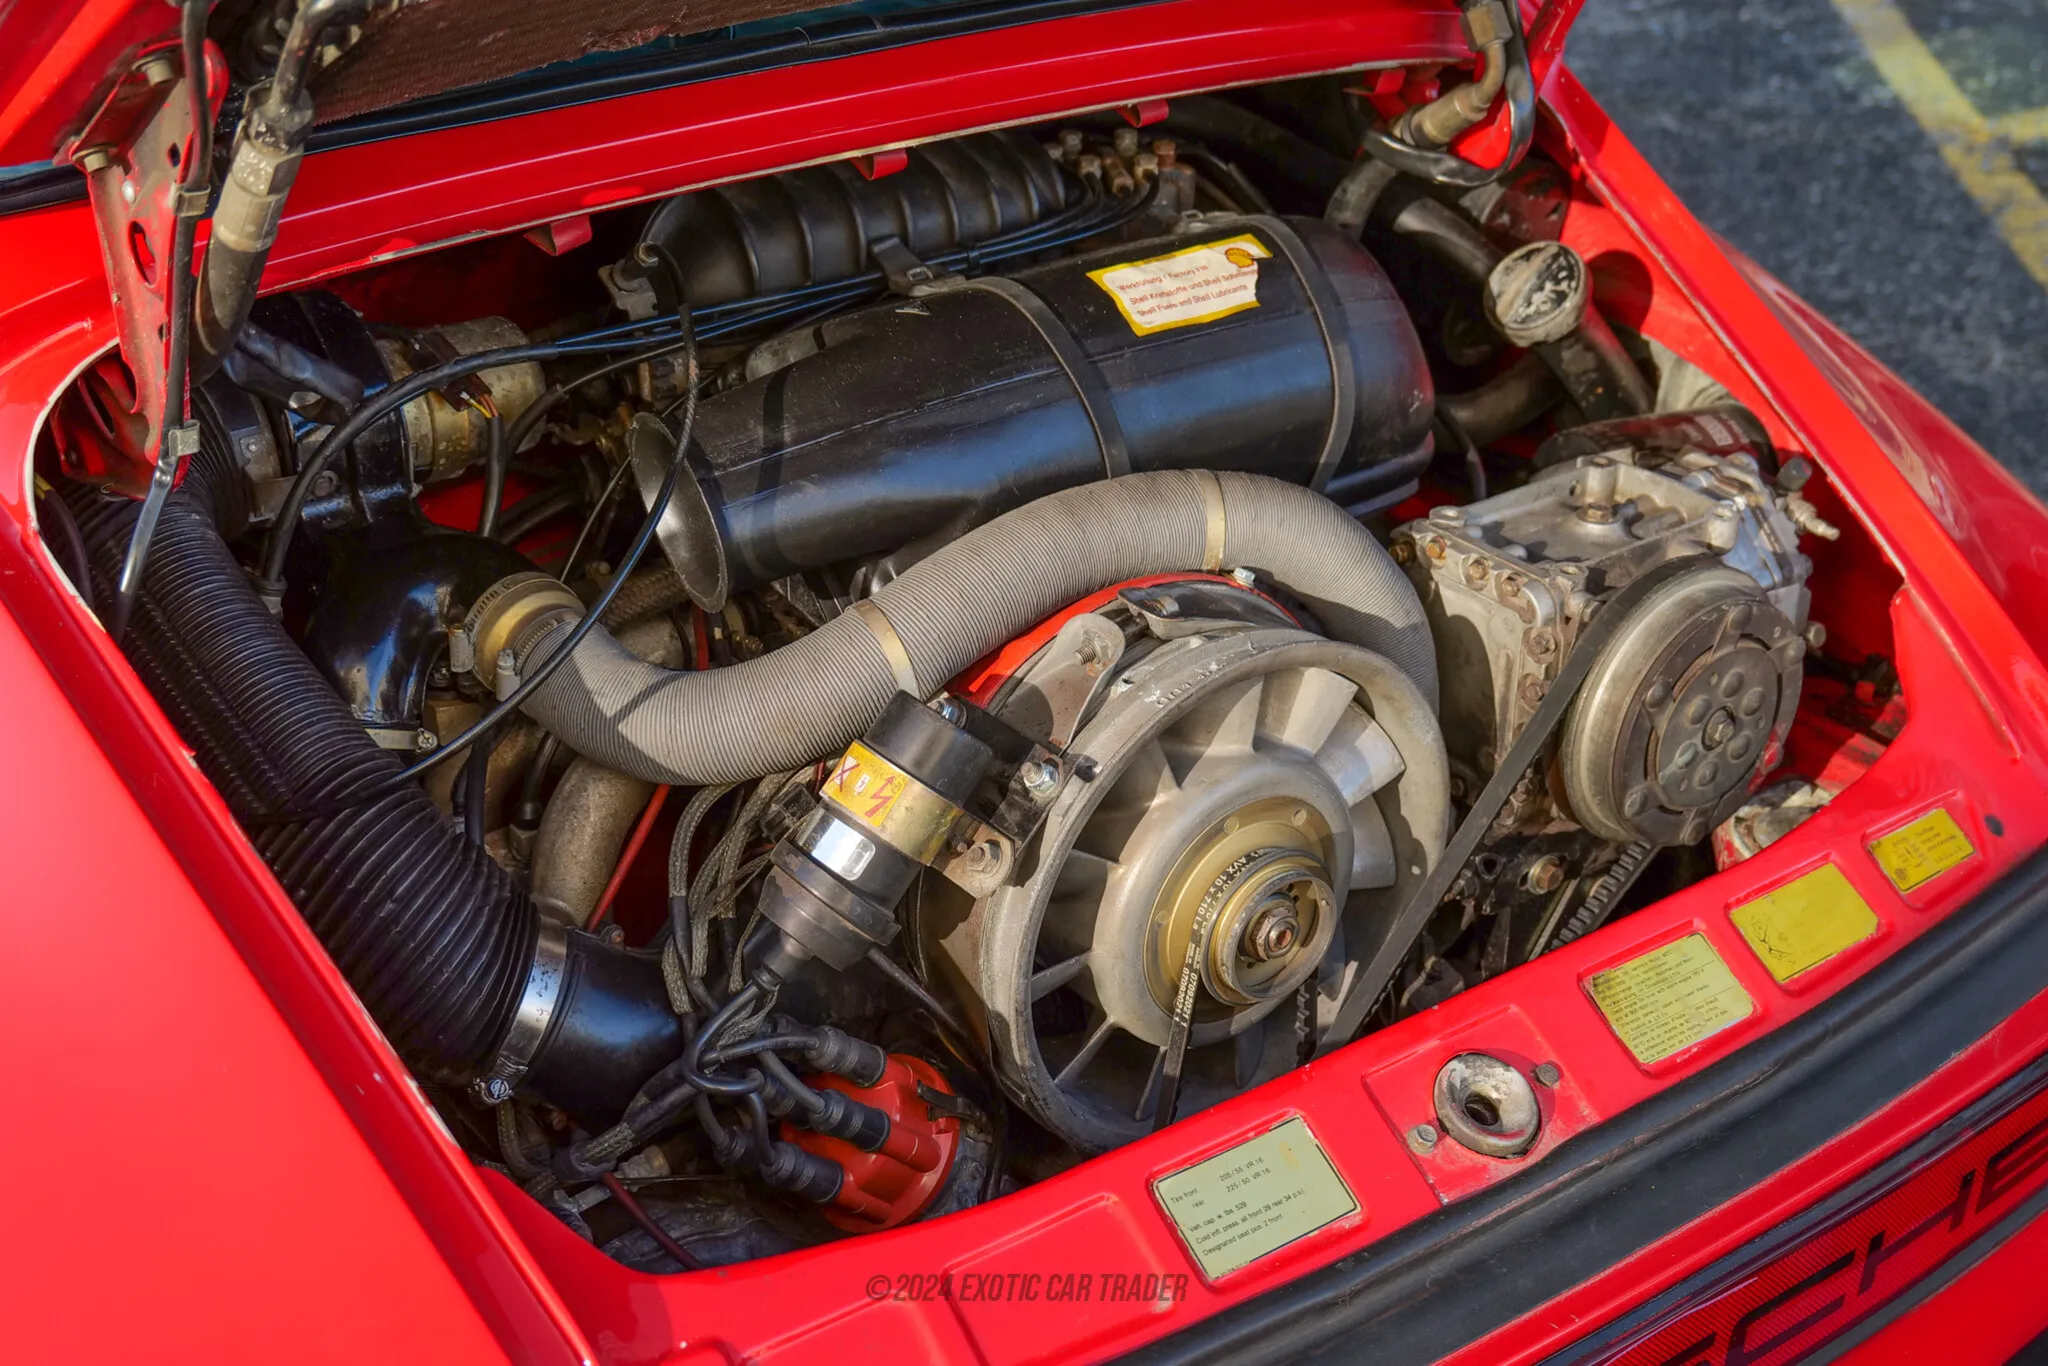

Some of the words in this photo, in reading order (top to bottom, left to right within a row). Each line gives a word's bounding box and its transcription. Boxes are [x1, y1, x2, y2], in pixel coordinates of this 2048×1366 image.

[1128, 295, 1150, 304] Shell
[1187, 281, 1203, 289] und
[1201, 276, 1222, 286] Shell
[1136, 307, 1158, 316] Shell
[1177, 298, 1193, 306] and
[1191, 293, 1211, 302] Shell
[1209, 284, 1248, 298] Lubricants
[1226, 857, 1246, 875] AVX
[1199, 896, 1212, 915] 710
[1183, 972, 1198, 1019] 07092021
[1169, 1193, 1184, 1204] Tire
[1182, 1187, 1199, 1198] front
[1244, 1160, 1255, 1169] VR
[1254, 1156, 1264, 1164] 16
[1191, 1199, 1206, 1208] rear
[1251, 1171, 1262, 1180] VR
[1261, 1167, 1271, 1175] 16
[1194, 1233, 1211, 1244] Cold
[1247, 1208, 1263, 1219] front
[1262, 1203, 1272, 1212] 29
[1270, 1198, 1284, 1208] rear
[1282, 1193, 1292, 1202] 34
[1234, 1200, 1247, 1211] 529
[1202, 1235, 1237, 1257] Designated
[1235, 1228, 1251, 1240] seat
[1267, 1212, 1283, 1224] front
